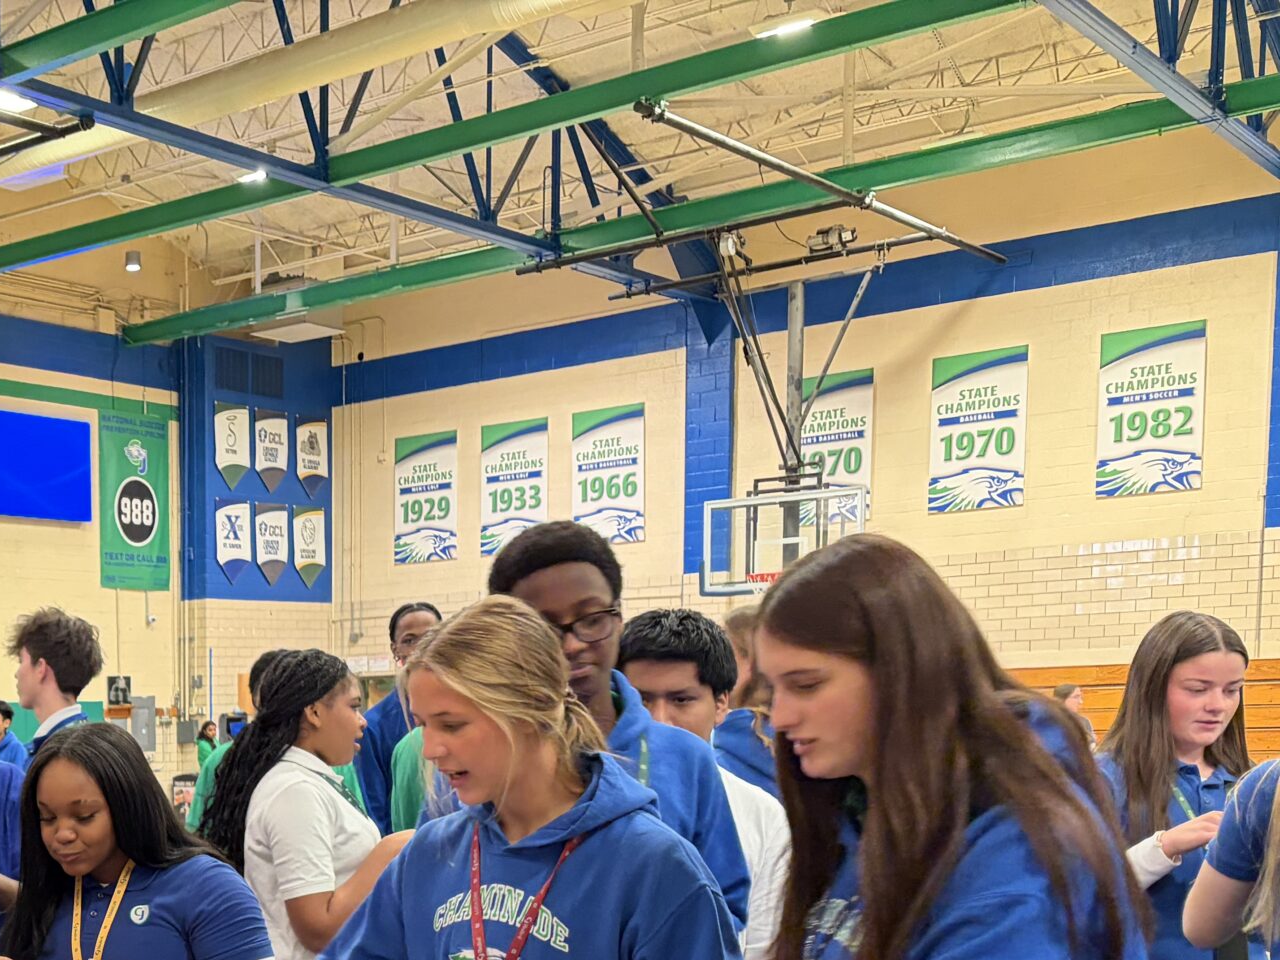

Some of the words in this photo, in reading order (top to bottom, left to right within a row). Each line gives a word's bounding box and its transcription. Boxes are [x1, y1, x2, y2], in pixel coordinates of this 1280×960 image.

[1130, 362, 1173, 379] STATE
[1105, 372, 1198, 395] CHAMPIONS
[959, 385, 998, 402] STATE
[1122, 394, 1147, 404] MEN'S
[1149, 390, 1179, 400] SOCCER
[937, 394, 1021, 416] CHAMPIONS
[811, 407, 847, 422] STATE
[959, 412, 995, 424] BASEBALL
[802, 416, 867, 435] HAMPIONS
[1109, 406, 1193, 444] 1982
[592, 436, 622, 450] STATE
[801, 435, 817, 445] EN'S
[818, 430, 859, 443] BASKETBALL
[939, 426, 1016, 462] 1970
[500, 450, 528, 463] STATE
[576, 445, 640, 463] CHAMPIONS
[412, 463, 439, 474] STATE
[484, 459, 544, 475] CHAMPIONS
[398, 471, 453, 487] CHAMPIONS
[577, 472, 639, 503] 1966
[488, 485, 543, 514] 1933
[120, 497, 153, 527] 988
[400, 496, 451, 525] 1929
[104, 551, 123, 561] TEXT
[136, 553, 154, 563] CALL
